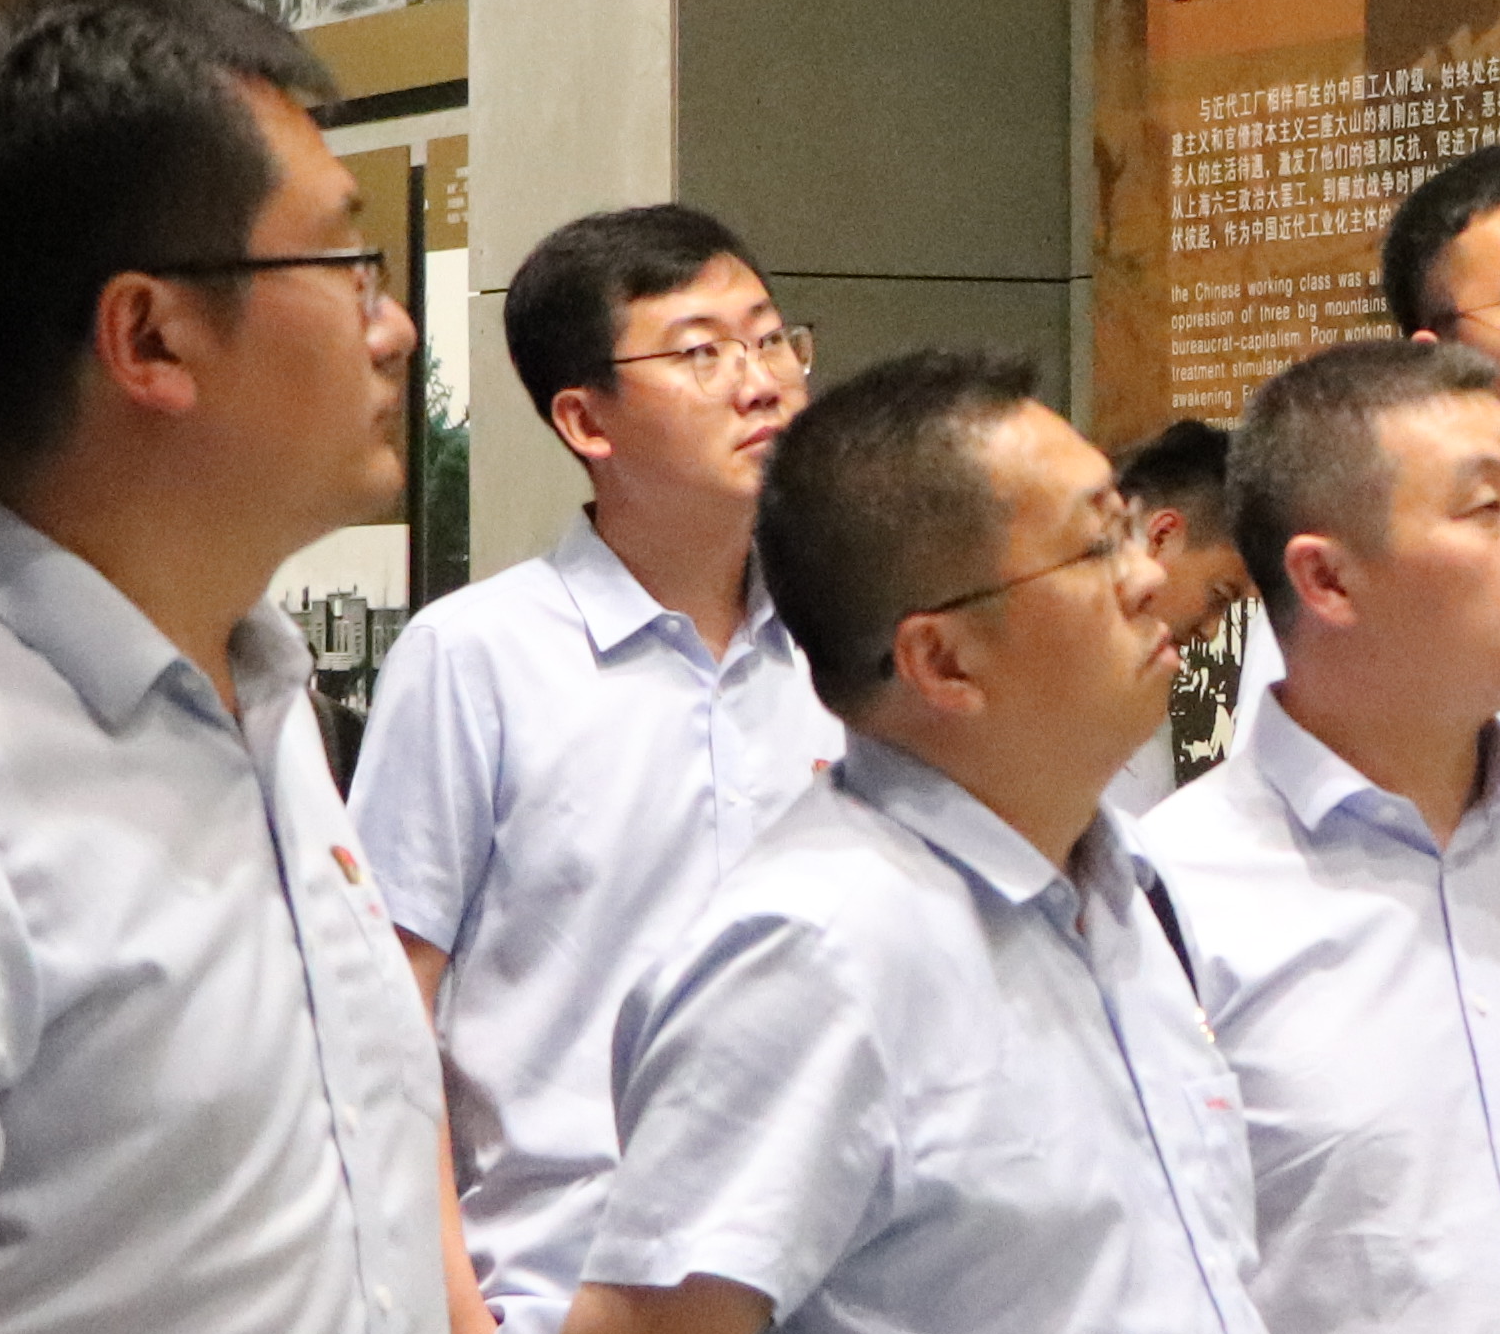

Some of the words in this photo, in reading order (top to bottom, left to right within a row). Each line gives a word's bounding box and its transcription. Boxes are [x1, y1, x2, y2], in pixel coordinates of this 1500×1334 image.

[1171, 162, 1452, 221] 从上海六三政治大罢工，到解放战争时期
[1171, 285, 1189, 303] the
[1195, 281, 1241, 301] Chinese
[1247, 275, 1293, 297] working
[1299, 272, 1332, 291] class
[1338, 271, 1362, 288] was
[1171, 309, 1234, 331] oppression
[1241, 307, 1252, 324] of
[1260, 304, 1291, 323] three
[1298, 299, 1317, 323] big
[1324, 294, 1388, 315] mountains
[1310, 324, 1338, 345] Poor
[1171, 361, 1226, 383] treatment
